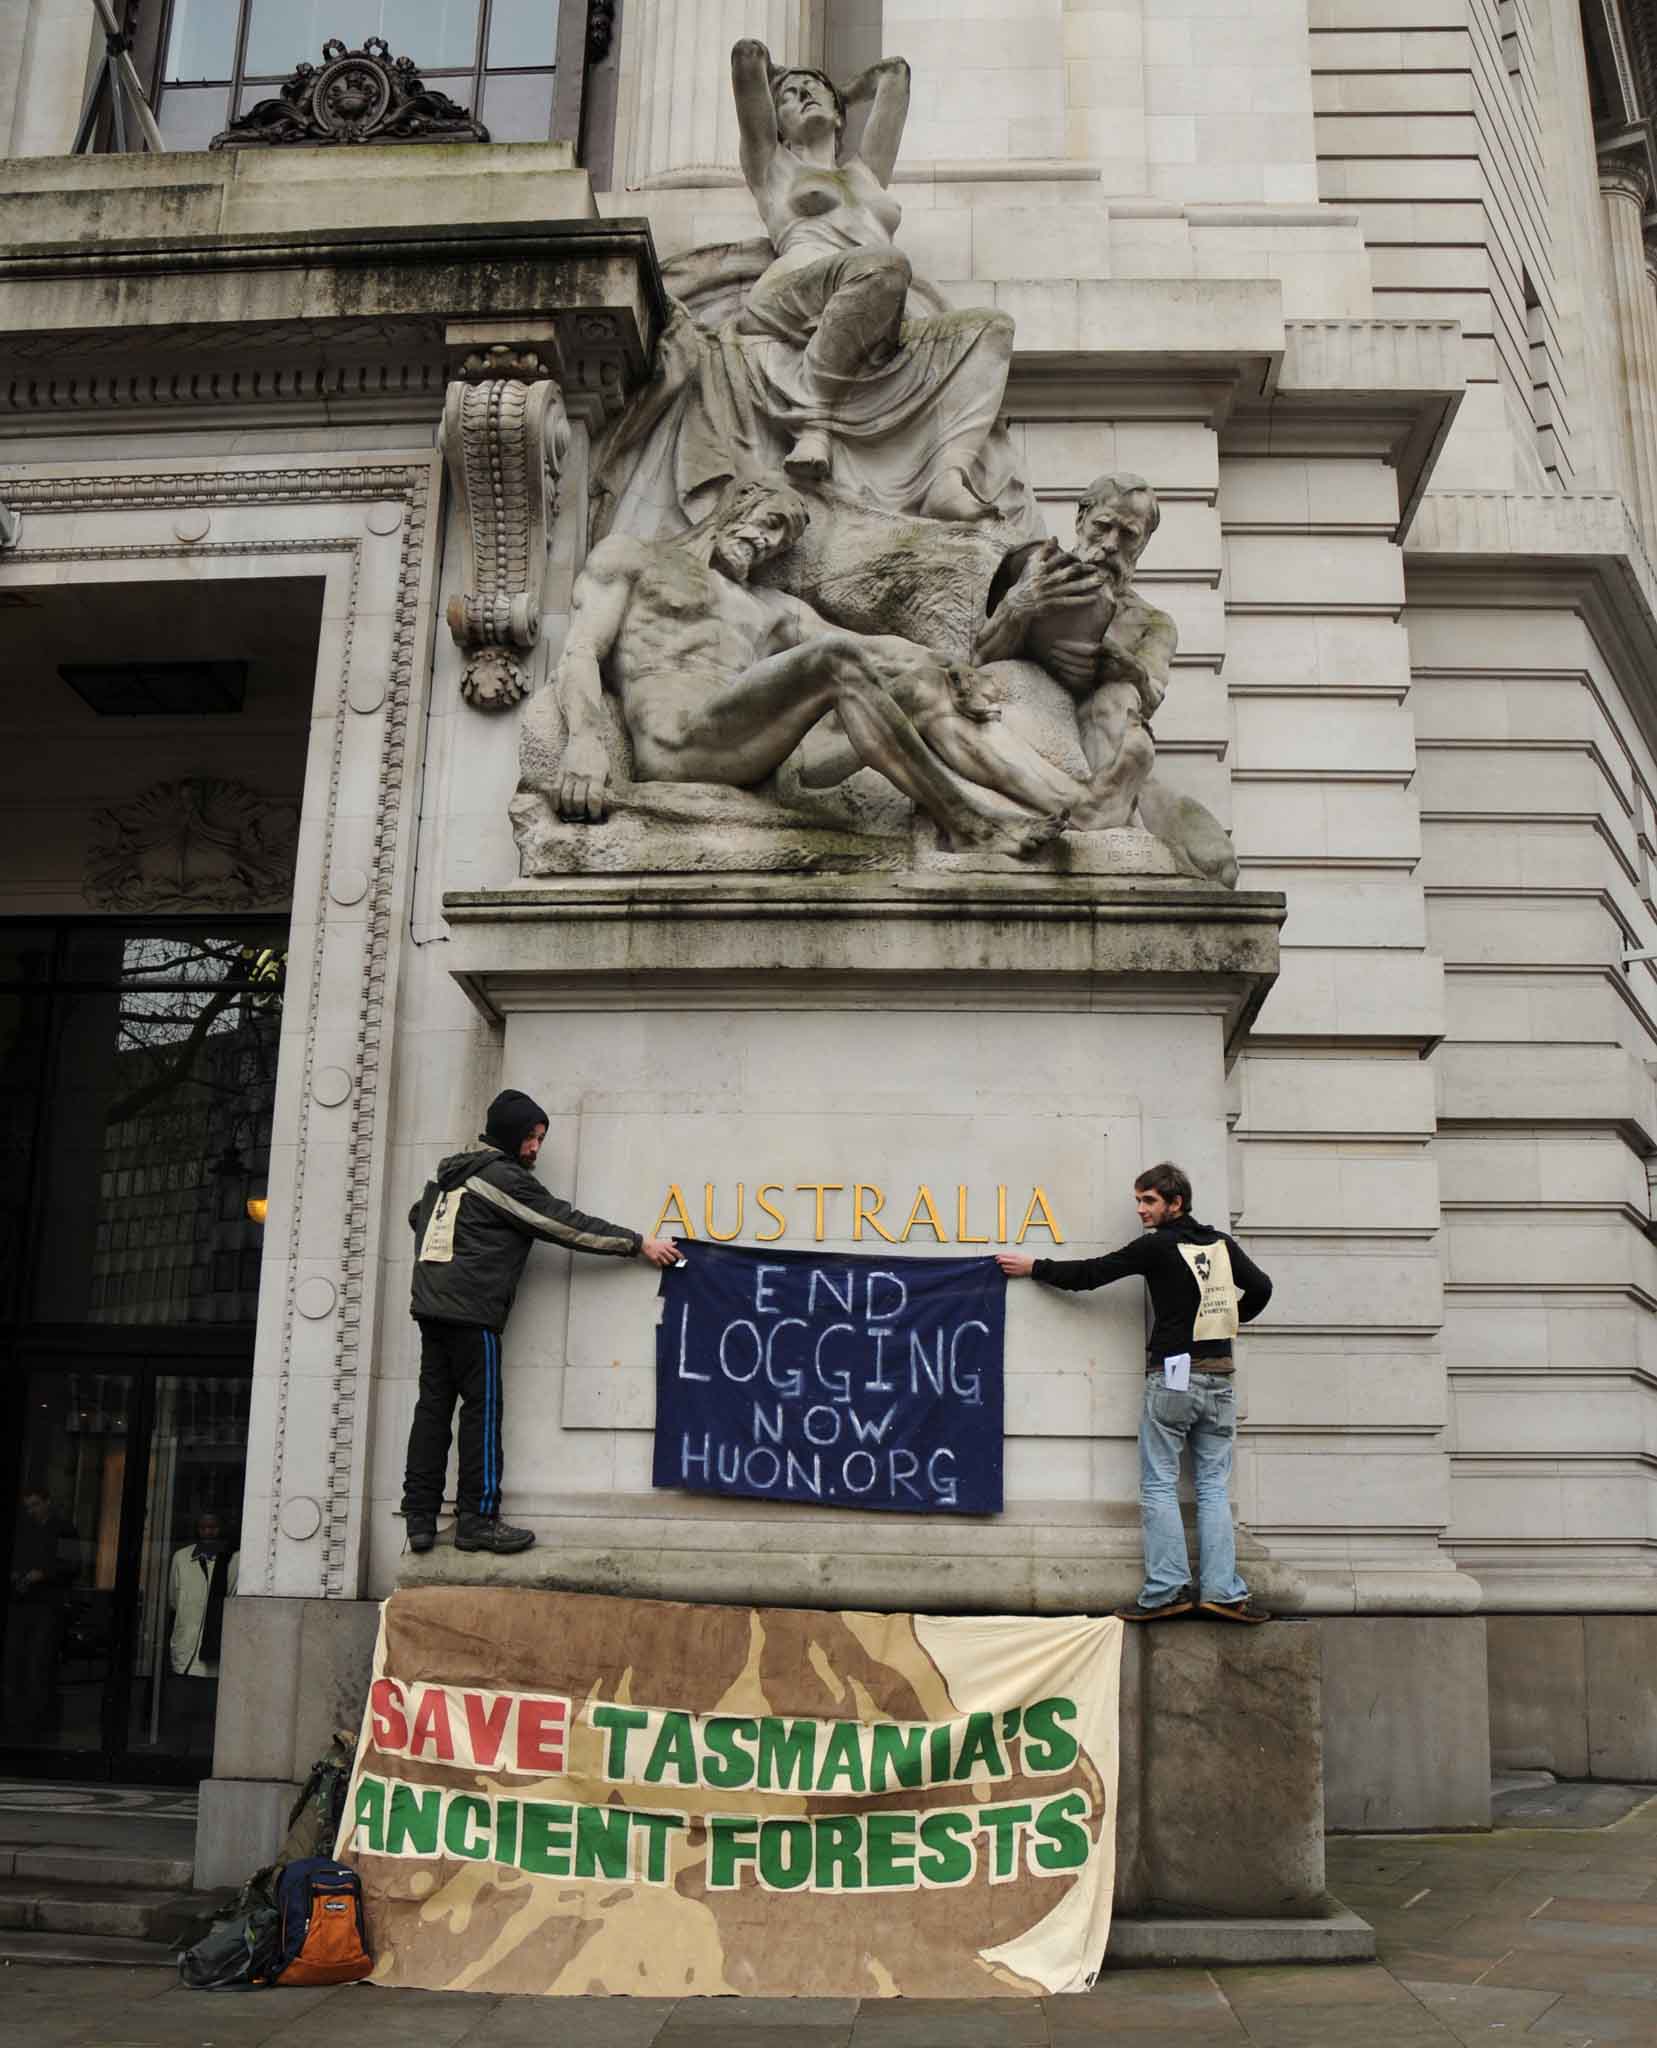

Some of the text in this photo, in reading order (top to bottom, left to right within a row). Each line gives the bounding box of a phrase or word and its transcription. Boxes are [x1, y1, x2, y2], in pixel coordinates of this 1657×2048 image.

[654, 1183, 1065, 1244] AUSTRALIA
[755, 1264, 908, 1321] END
[678, 1302, 990, 1405] LOGGING
[753, 1402, 898, 1445] NOW
[681, 1431, 958, 1506] HUON.ORG
[371, 1678, 1079, 1793] SAVE TASMANIA'S
[353, 1777, 1089, 1891] ANCIENT FORESTS
